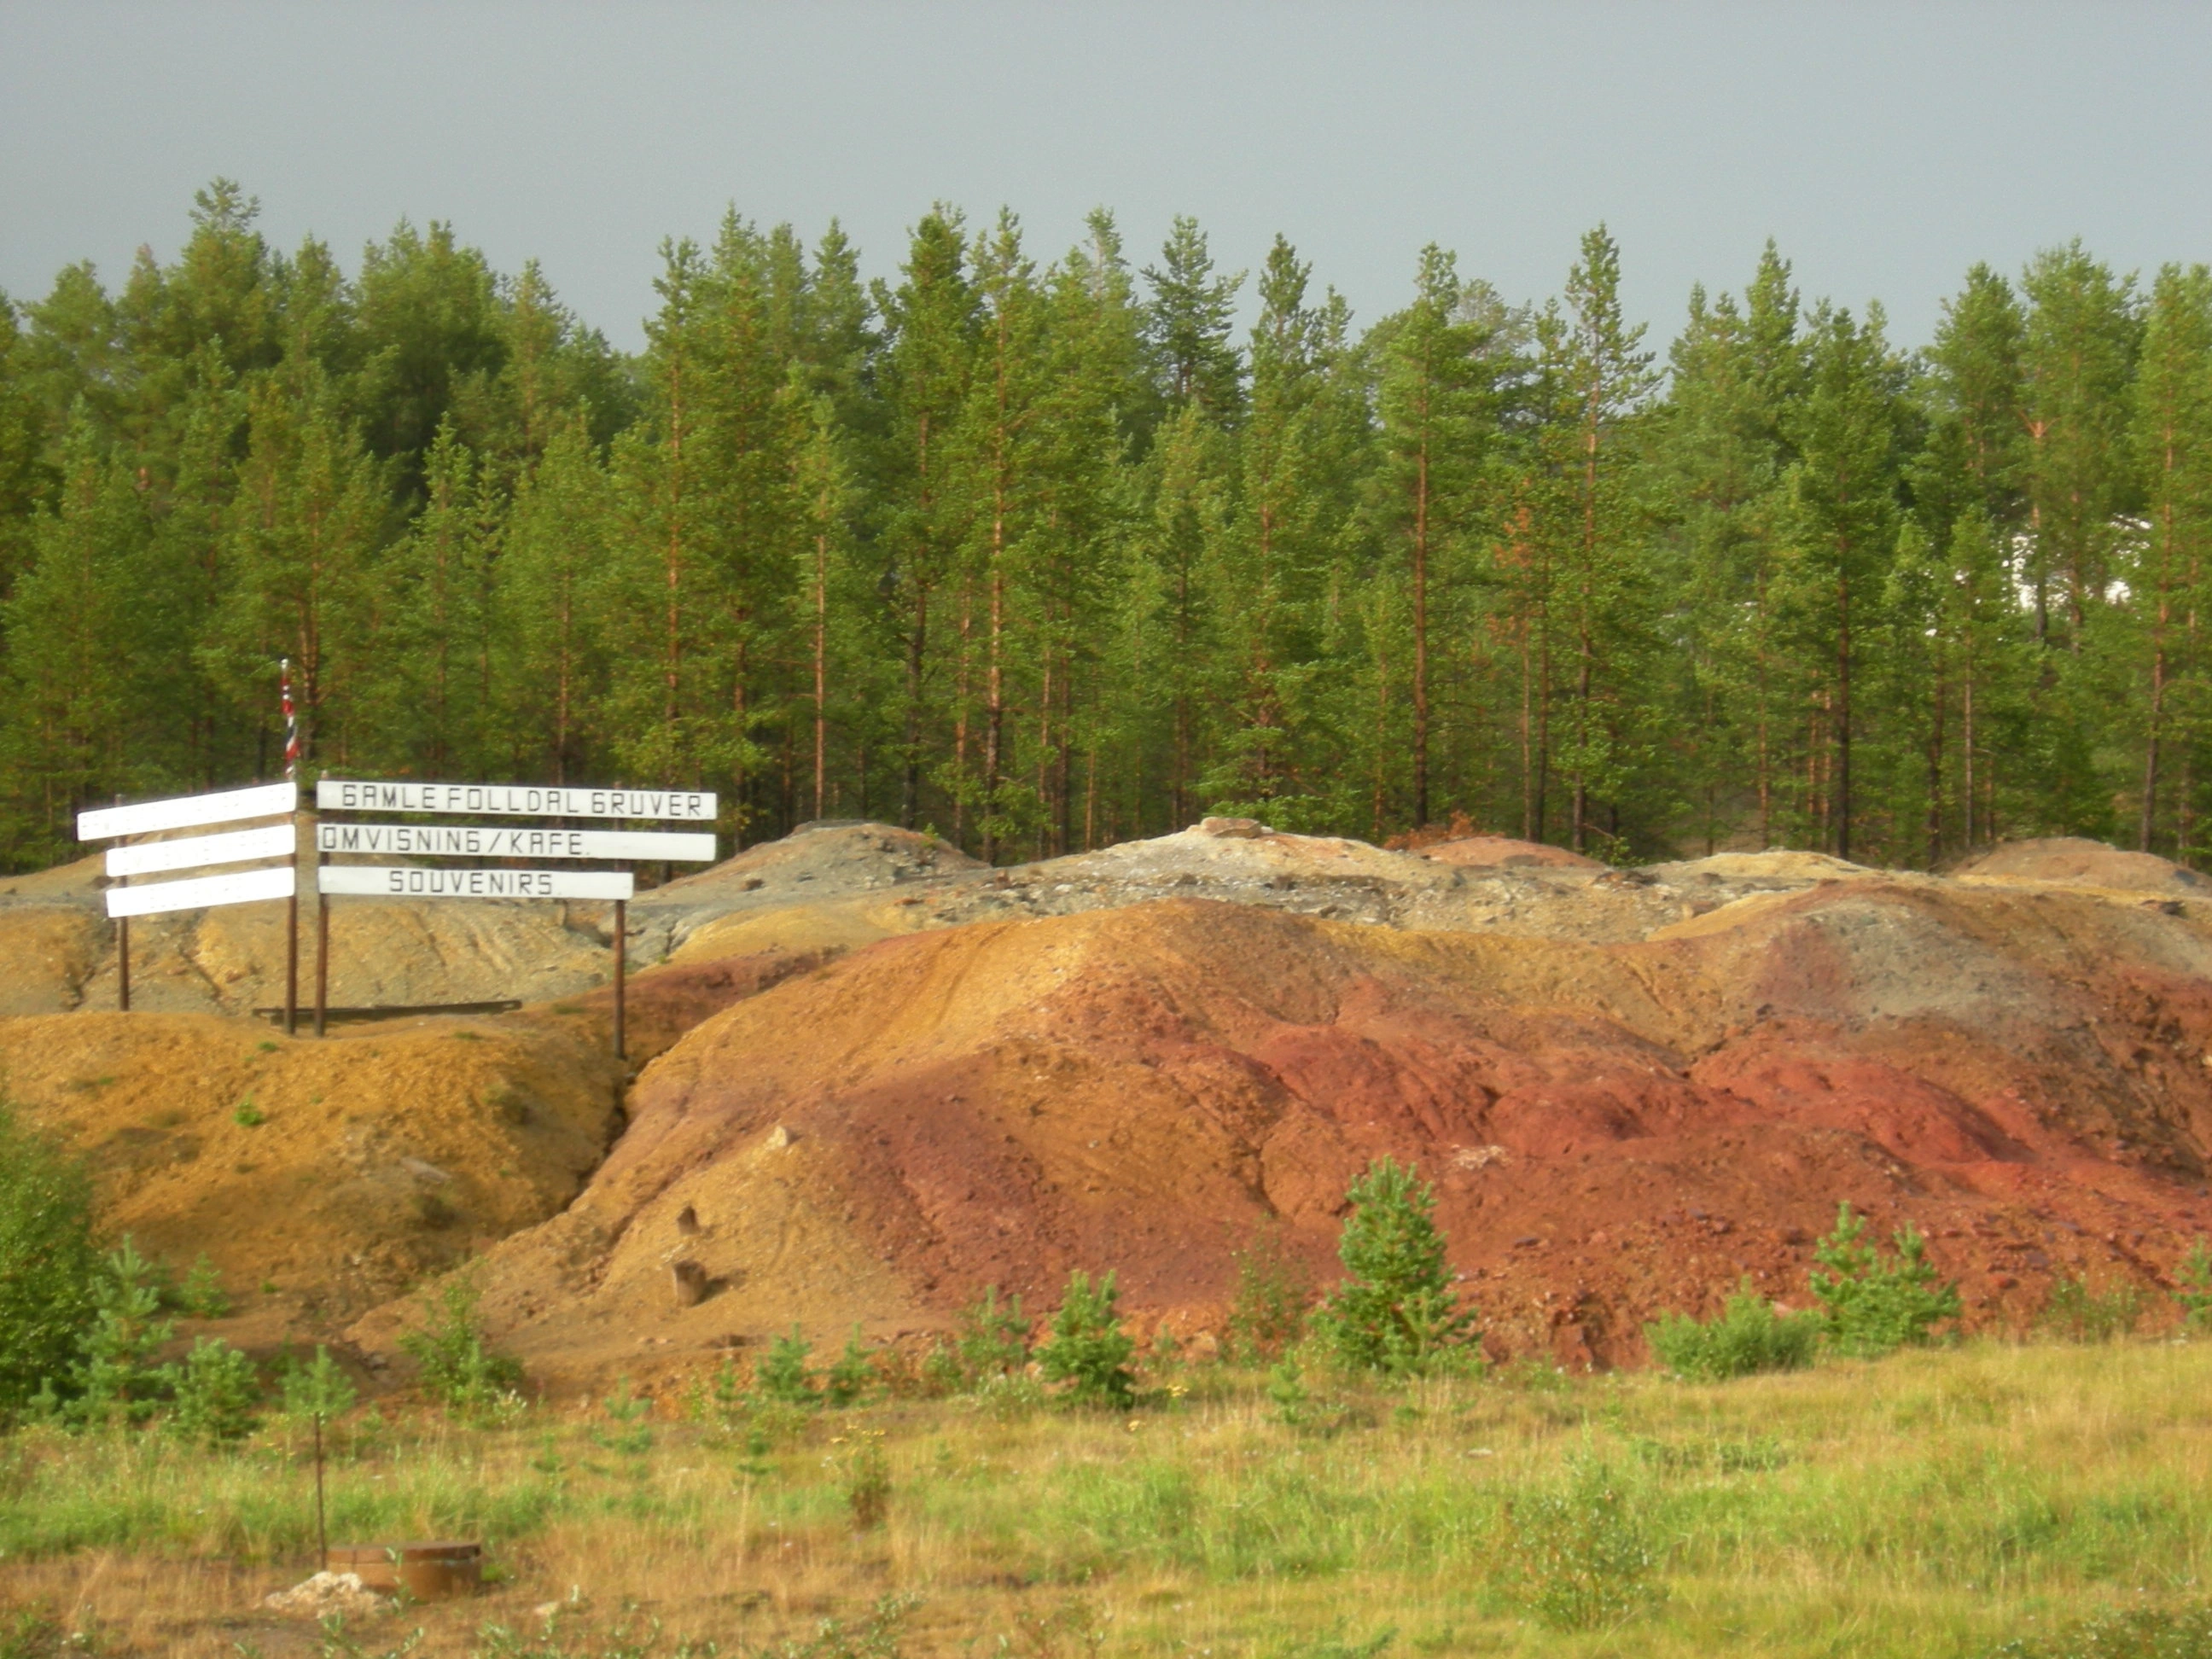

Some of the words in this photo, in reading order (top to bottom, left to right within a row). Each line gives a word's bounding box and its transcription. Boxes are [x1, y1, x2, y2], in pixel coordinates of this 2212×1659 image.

[342, 783, 436, 809] GAMLE
[448, 787, 579, 813] FOLLDAL
[591, 791, 701, 817] GRUVER
[389, 870, 552, 895] SOUVENIRS
